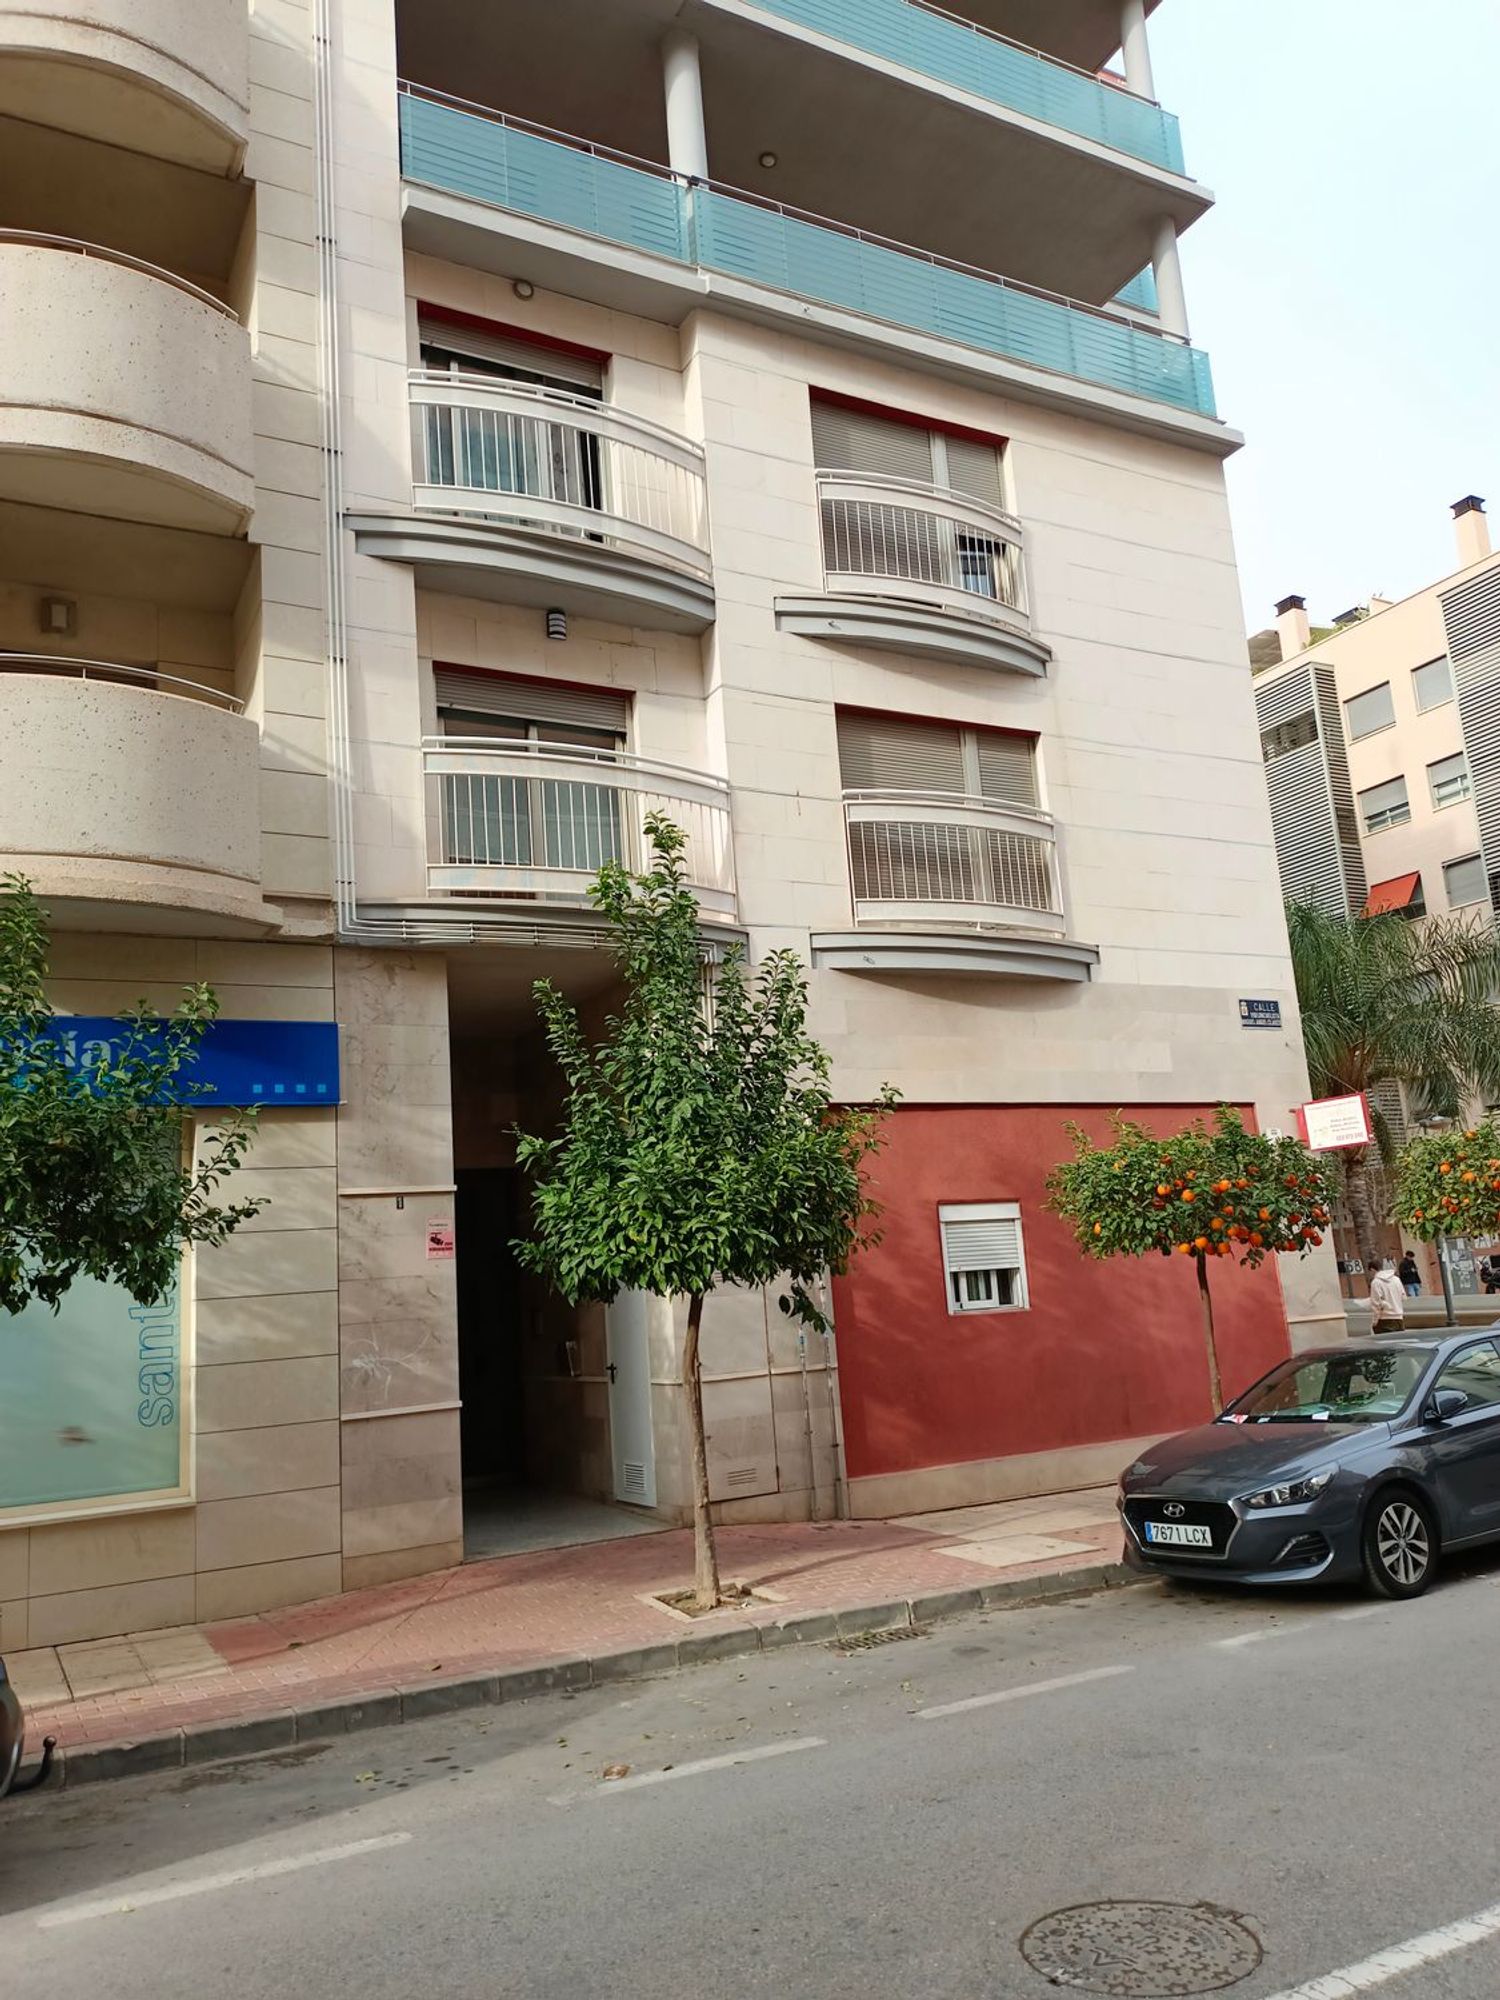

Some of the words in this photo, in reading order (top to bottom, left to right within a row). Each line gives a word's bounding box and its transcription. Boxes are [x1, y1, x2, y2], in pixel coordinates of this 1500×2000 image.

[1253, 1002, 1276, 1012] CALLE
[128, 1287, 175, 1428] sant
[1153, 1525, 1182, 1542] 7671
[1185, 1528, 1209, 1544] LCX
